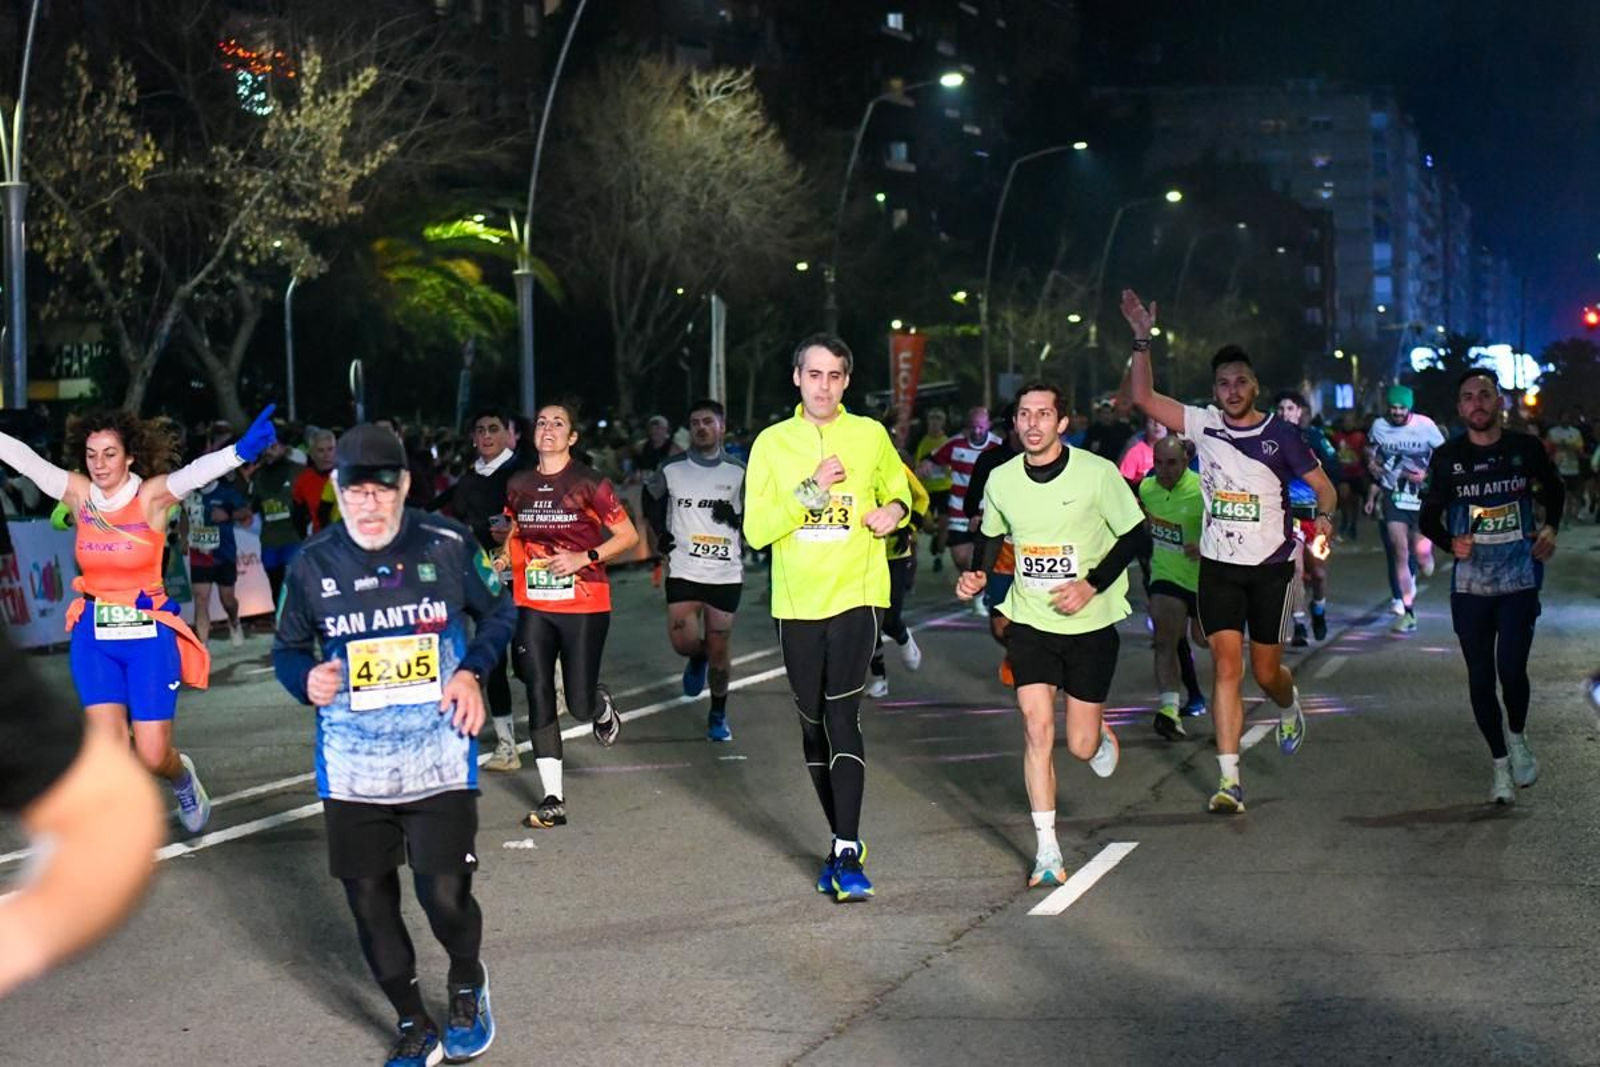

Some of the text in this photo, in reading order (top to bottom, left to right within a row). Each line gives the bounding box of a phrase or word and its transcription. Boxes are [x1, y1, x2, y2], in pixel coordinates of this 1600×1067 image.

[1456, 475, 1527, 498] SAN ANTÓN
[677, 498, 693, 508] FS
[1214, 501, 1257, 517] 1463
[1151, 522, 1181, 541] 2523
[1477, 513, 1517, 532] 375
[693, 543, 729, 557] 7923
[1024, 556, 1072, 573] 9529
[325, 614, 366, 638] SAN
[372, 597, 448, 631] ANTÓN
[357, 654, 431, 682] 4205
